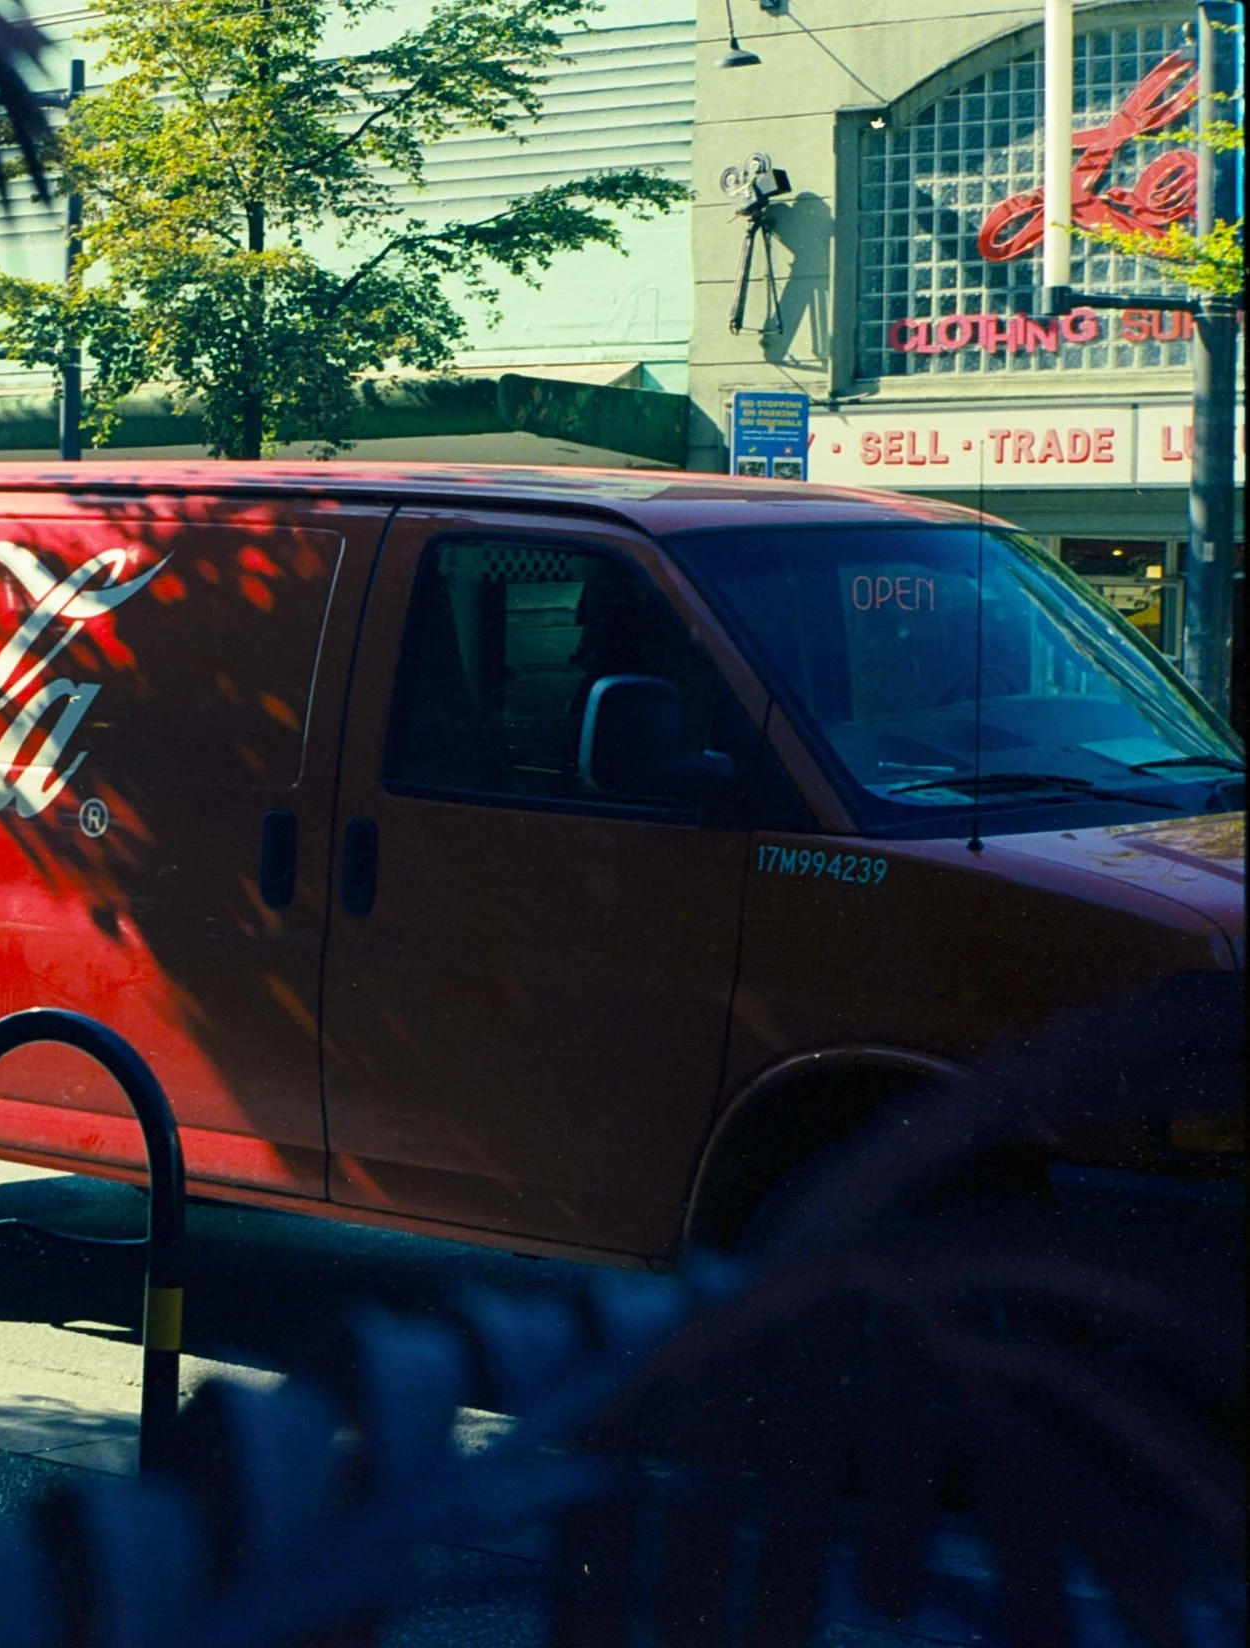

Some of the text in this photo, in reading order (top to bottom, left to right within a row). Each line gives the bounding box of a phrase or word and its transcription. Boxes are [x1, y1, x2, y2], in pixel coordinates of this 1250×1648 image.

[889, 306, 1099, 353] CLOTHING
[860, 427, 1116, 465] SELL TRADE
[852, 575, 934, 611] OPEN
[757, 845, 888, 885] 17M994239
